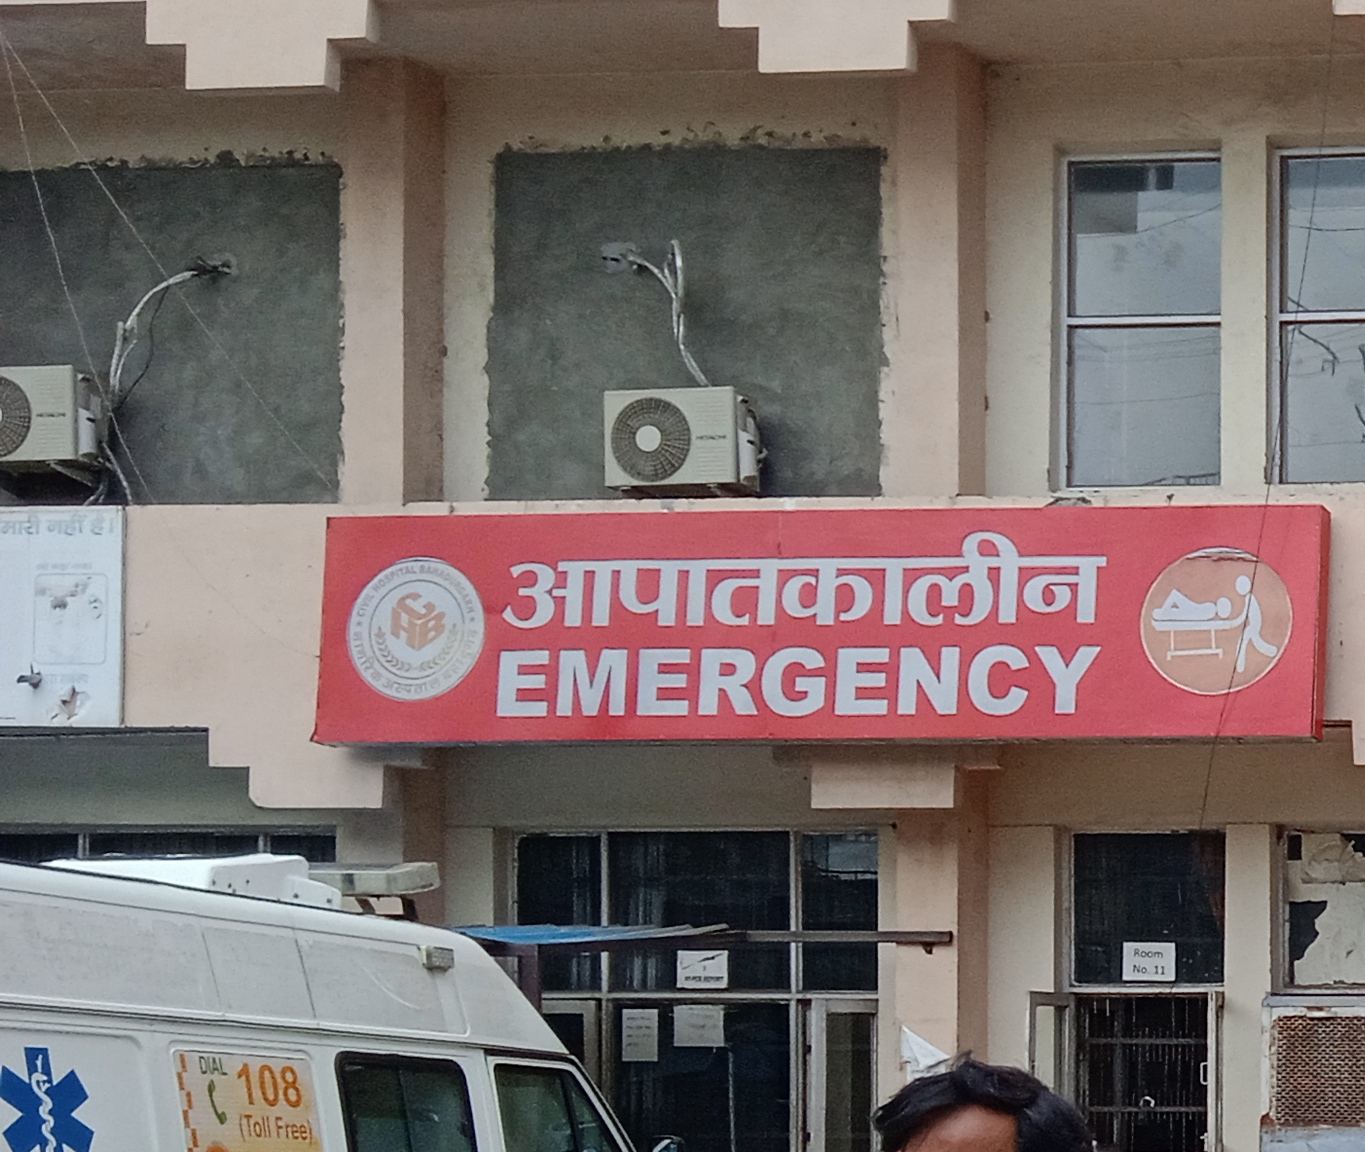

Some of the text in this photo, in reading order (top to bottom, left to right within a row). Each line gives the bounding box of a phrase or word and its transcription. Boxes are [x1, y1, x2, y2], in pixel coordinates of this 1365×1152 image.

[357, 593, 375, 618] CIVIL
[372, 565, 417, 592] HOSPITAL
[501, 531, 1108, 630] आपातकालीन
[496, 645, 1102, 717] EMERGENCY
[1133, 948, 1163, 958] Room
[1154, 965, 1165, 976] 11
[199, 1056, 229, 1076] DIAL
[237, 1062, 303, 1108] 108
[239, 1113, 313, 1146] (Toll Free)
